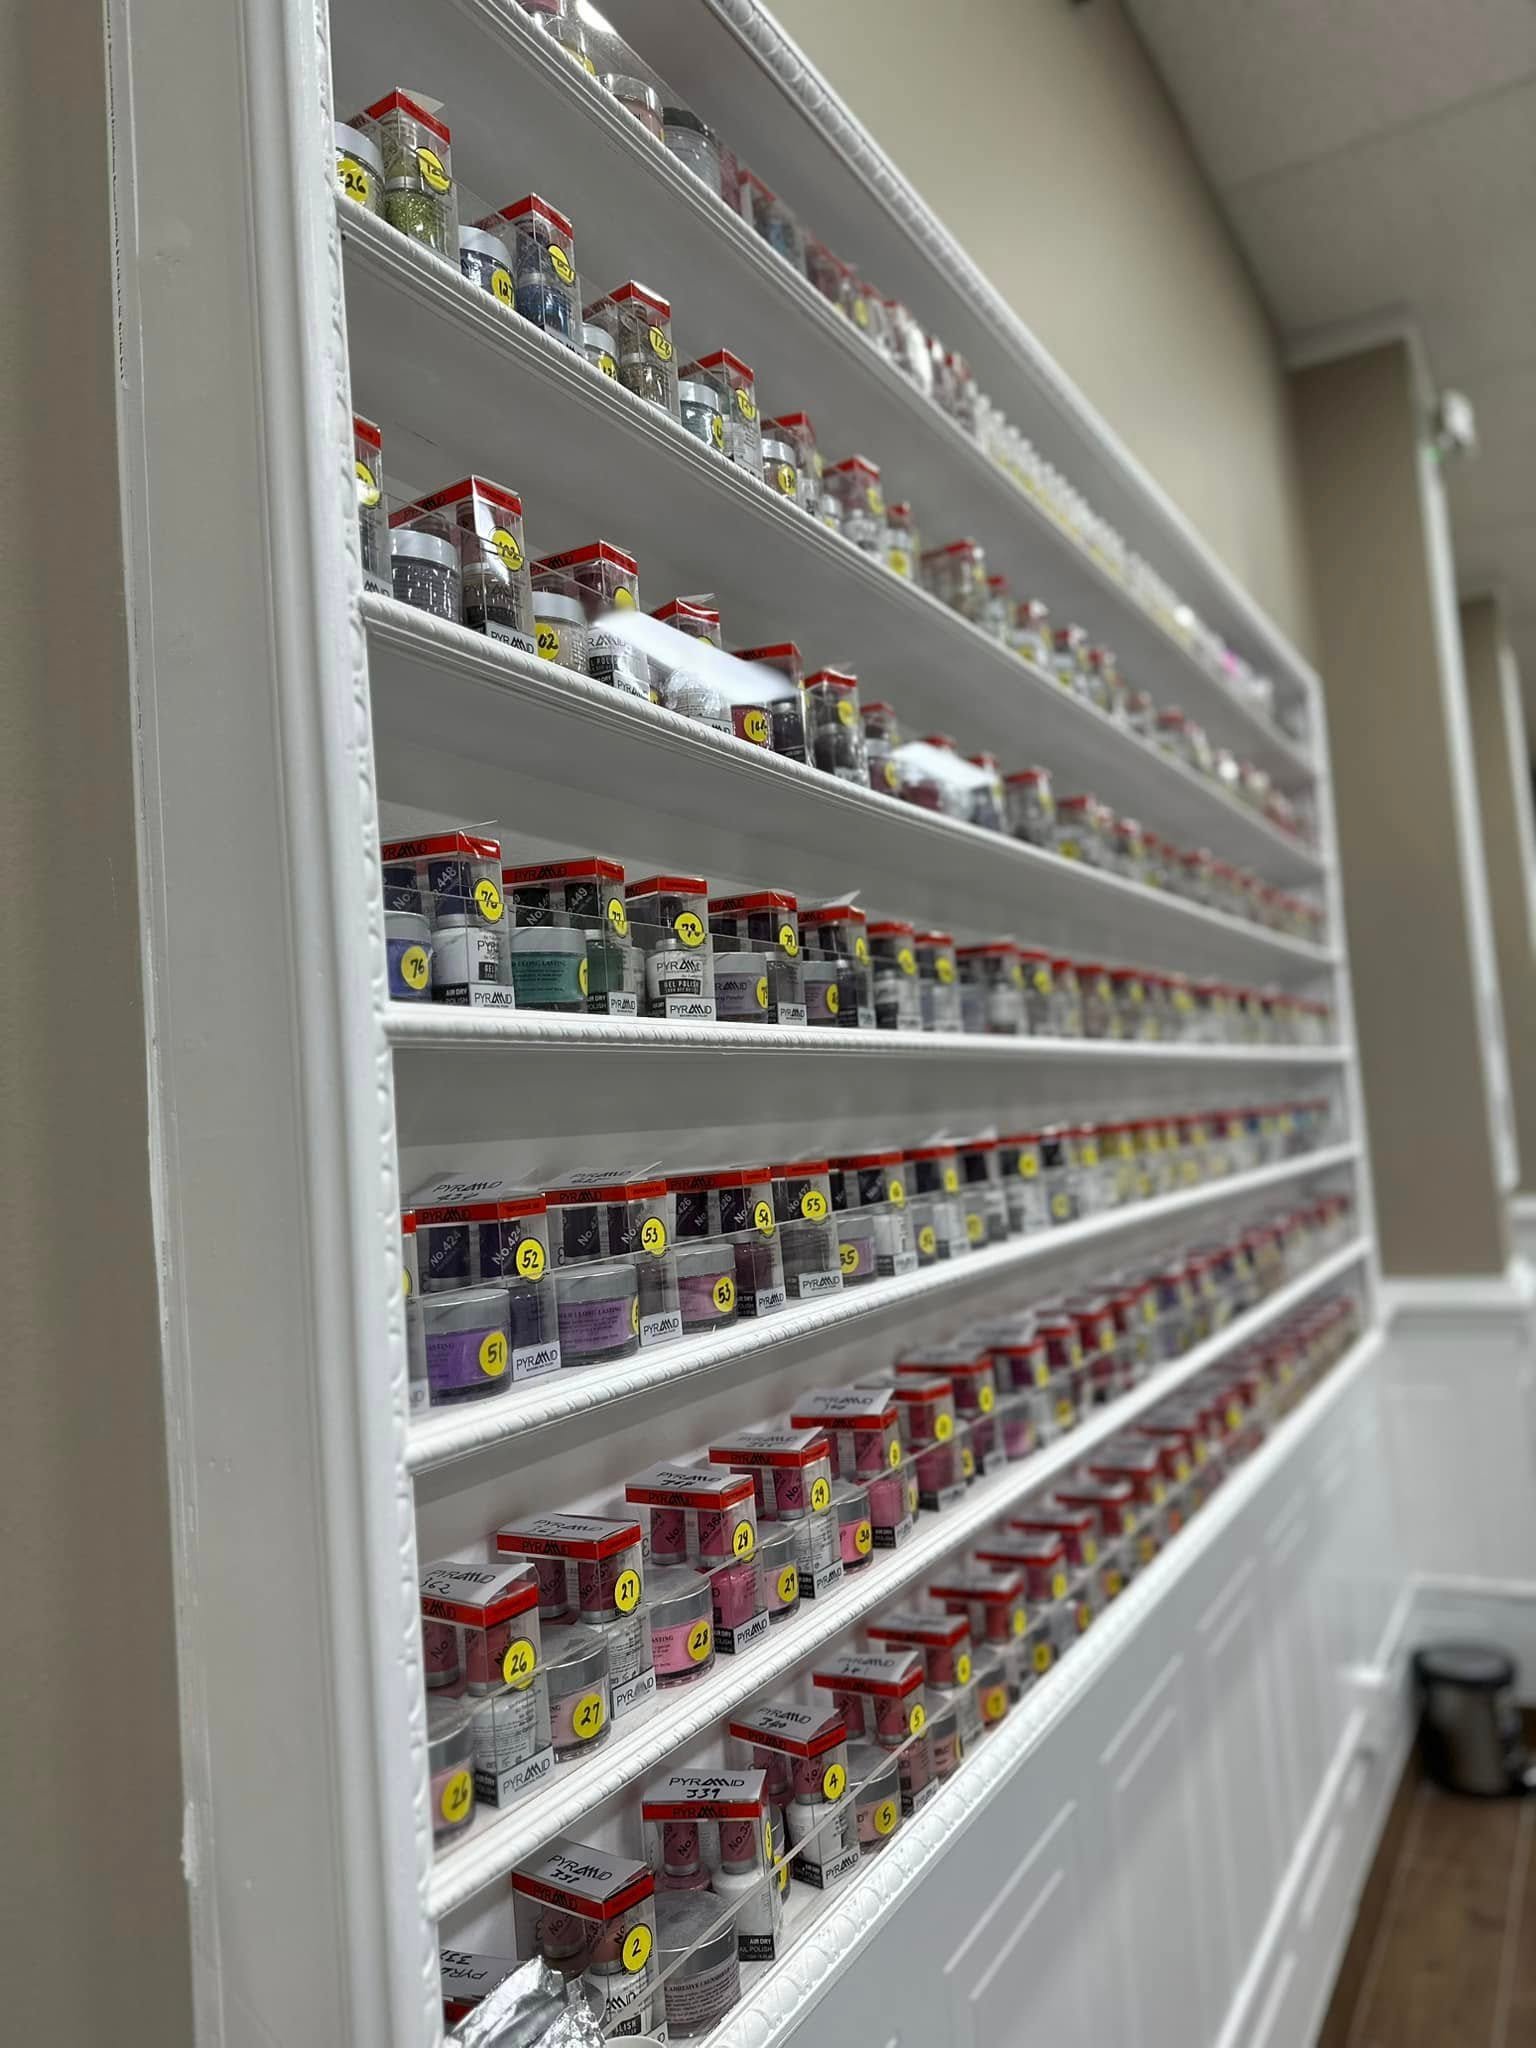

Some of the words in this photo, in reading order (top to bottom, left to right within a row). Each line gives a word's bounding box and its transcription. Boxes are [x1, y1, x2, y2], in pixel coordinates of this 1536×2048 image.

[491, 631, 535, 654] PYRAMID
[538, 633, 558, 650] 02
[481, 891, 498, 909] 76
[410, 958, 425, 978] 76
[474, 991, 512, 1005] PYRAMID
[611, 999, 635, 1011] PYRAMID
[670, 1004, 712, 1015] PYRAMID
[433, 1181, 503, 1192] PYRAMID
[423, 1208, 470, 1221] PYRAMID
[807, 1198, 821, 1212] 55
[643, 1227, 658, 1244] 53
[522, 1249, 539, 1269] 52
[803, 1275, 840, 1289] PYRAMID
[718, 1283, 731, 1304] 53
[759, 1292, 784, 1306] PYRAMID
[644, 1318, 679, 1336] PYRAMID
[487, 1341, 503, 1364] 51
[516, 1349, 558, 1370] PYRAMID
[533, 1519, 603, 1531] PYRAMID
[522, 1540, 569, 1554] PYRAMID
[784, 1573, 795, 1594] 29
[817, 1567, 842, 1590] PYRAMID
[621, 1579, 634, 1601] 27
[693, 1628, 709, 1650] 28
[737, 1618, 768, 1644] PYRAMID
[510, 1651, 528, 1676] 26
[580, 1702, 600, 1727] 27
[758, 1706, 811, 1725] PYRAMID
[502, 1758, 550, 1795] PYRAMID
[669, 1777, 745, 1788] PYRAMID
[450, 1775, 468, 1811] 26
[672, 1805, 729, 1818] PYRAMID
[883, 1809, 892, 1826] 5
[549, 1853, 613, 1882] PYRAMID
[825, 1853, 859, 1880] PYRAMID
[632, 1938, 641, 1957] 2
